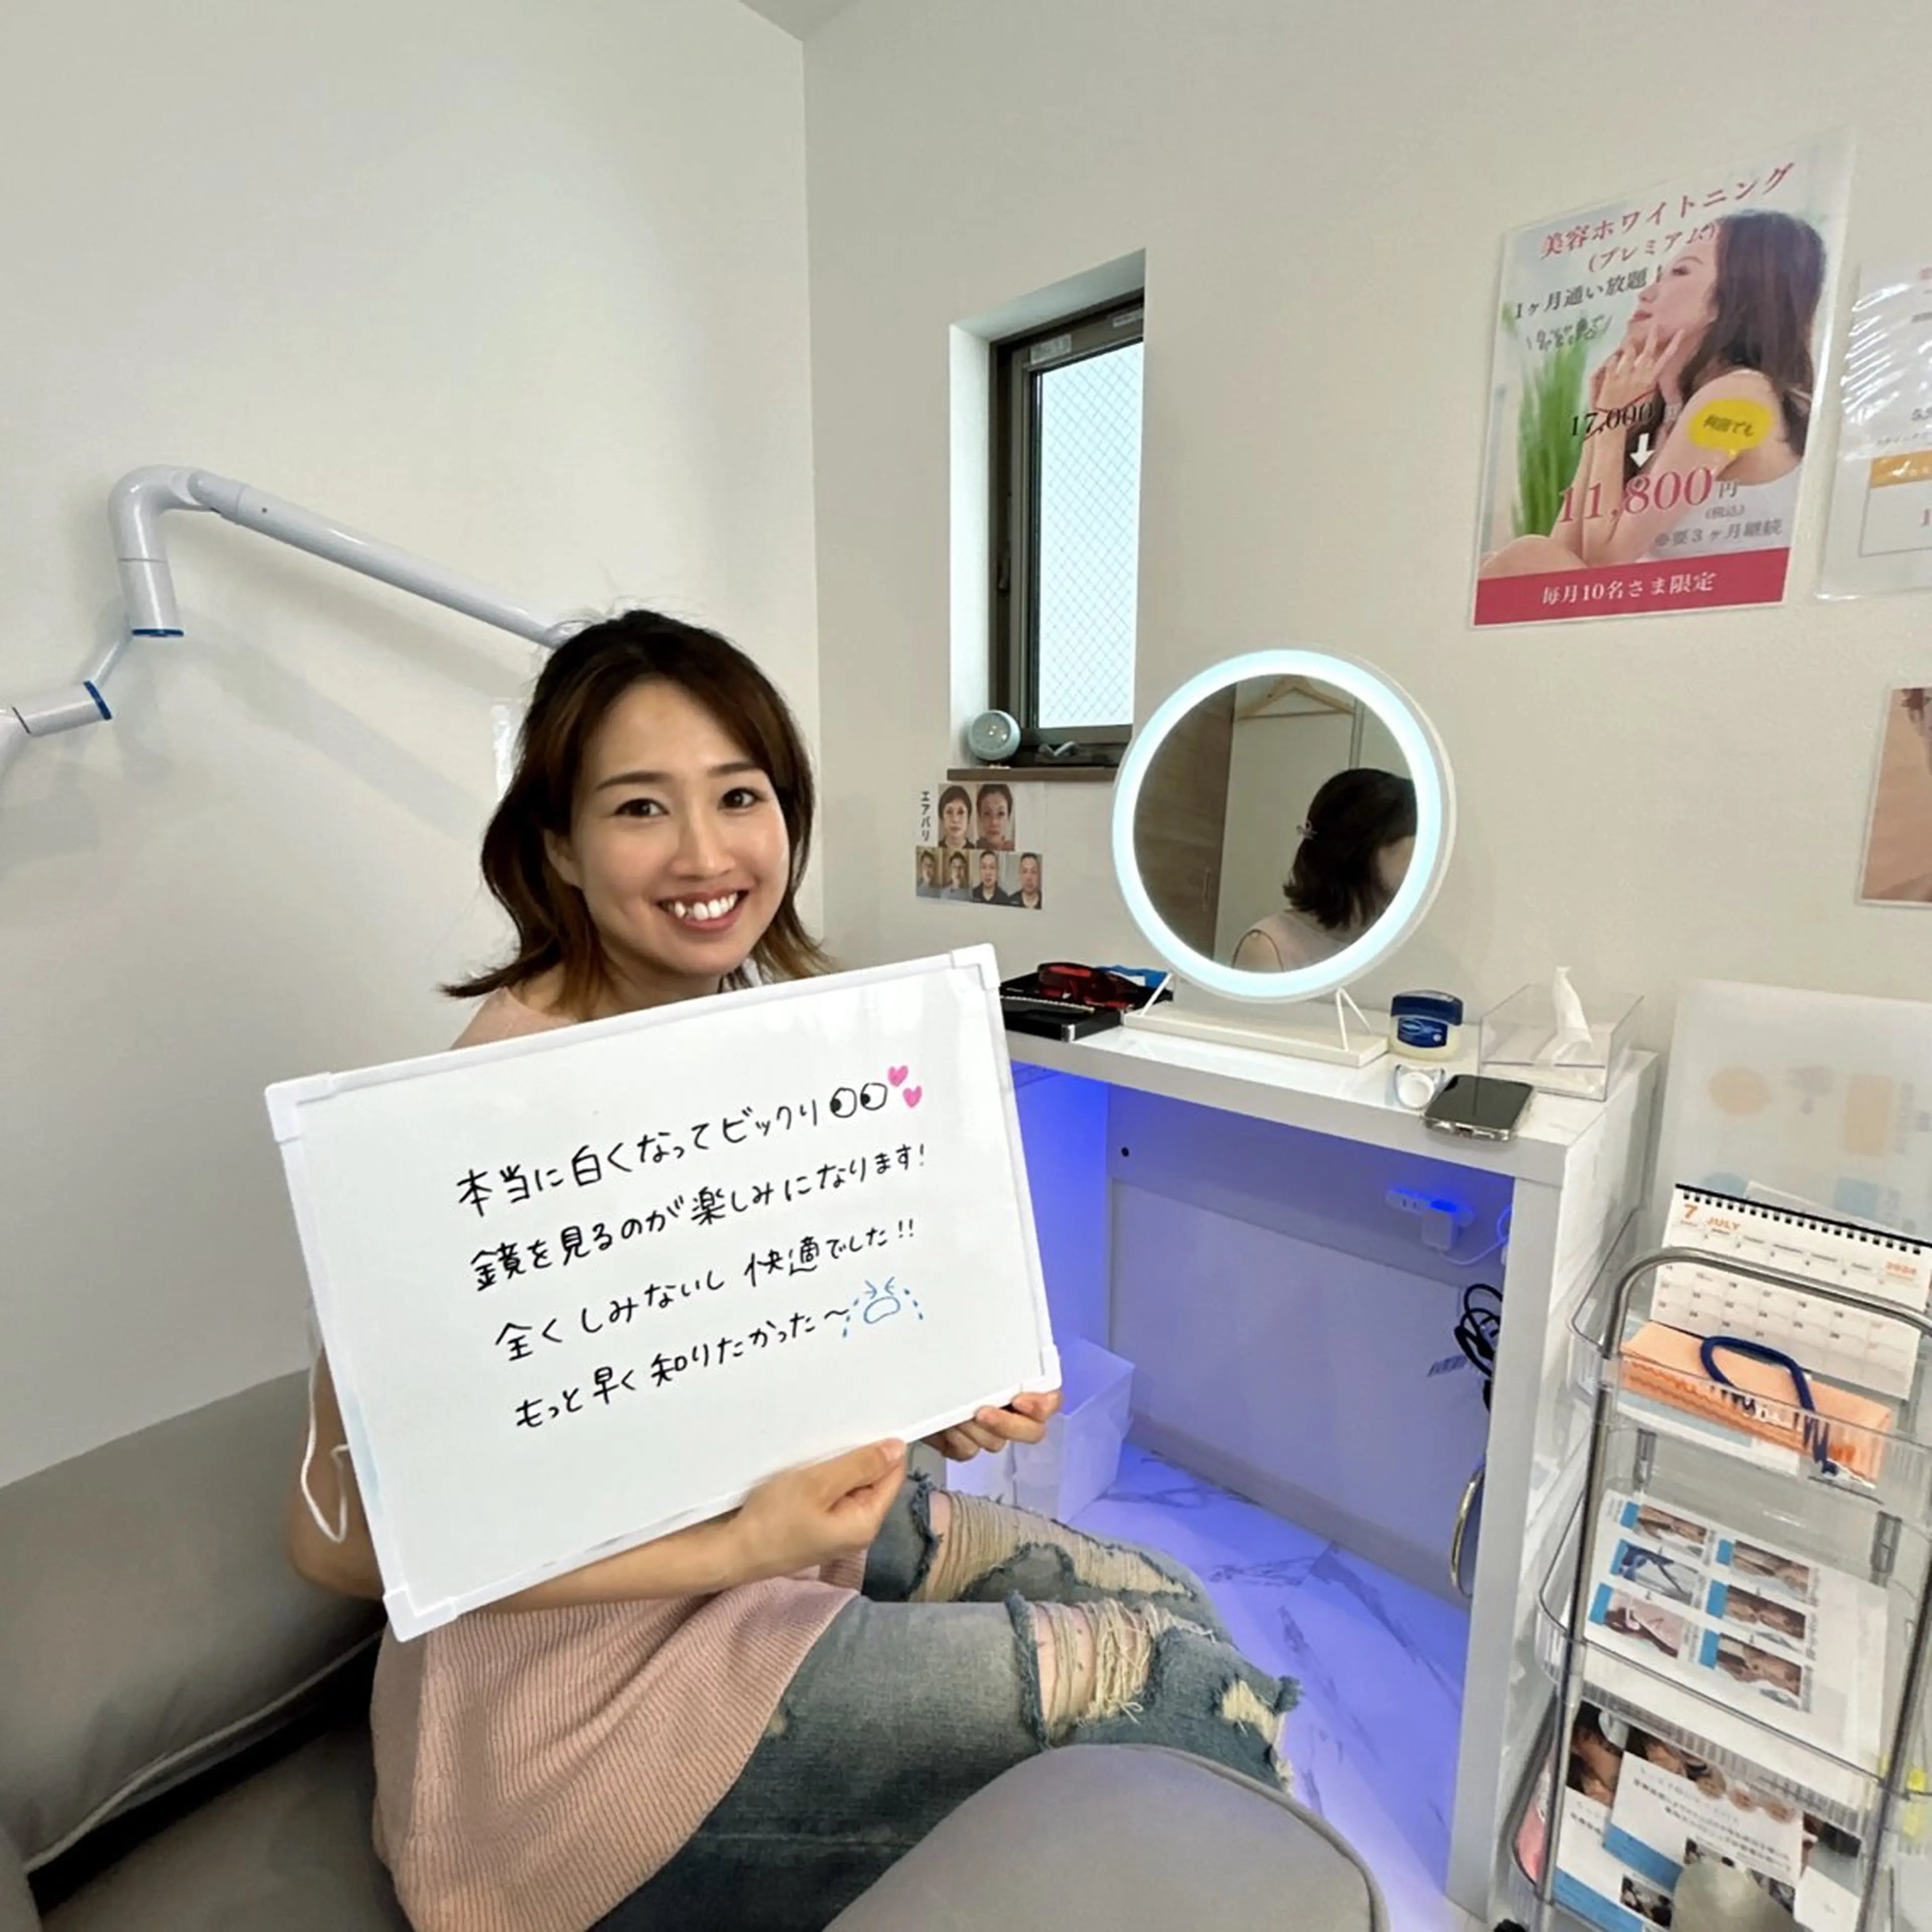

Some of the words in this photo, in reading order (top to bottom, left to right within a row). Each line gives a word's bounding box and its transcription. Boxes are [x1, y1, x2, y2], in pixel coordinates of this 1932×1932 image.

[1541, 162, 1795, 260] 美容ホワイトニング
[1542, 571, 1718, 606] 毎月10名さま限定
[456, 1099, 818, 1218] 本当に白くなってビックリ
[1683, 1203, 1699, 1220] 7
[1705, 1216, 1742, 1231] JULY
